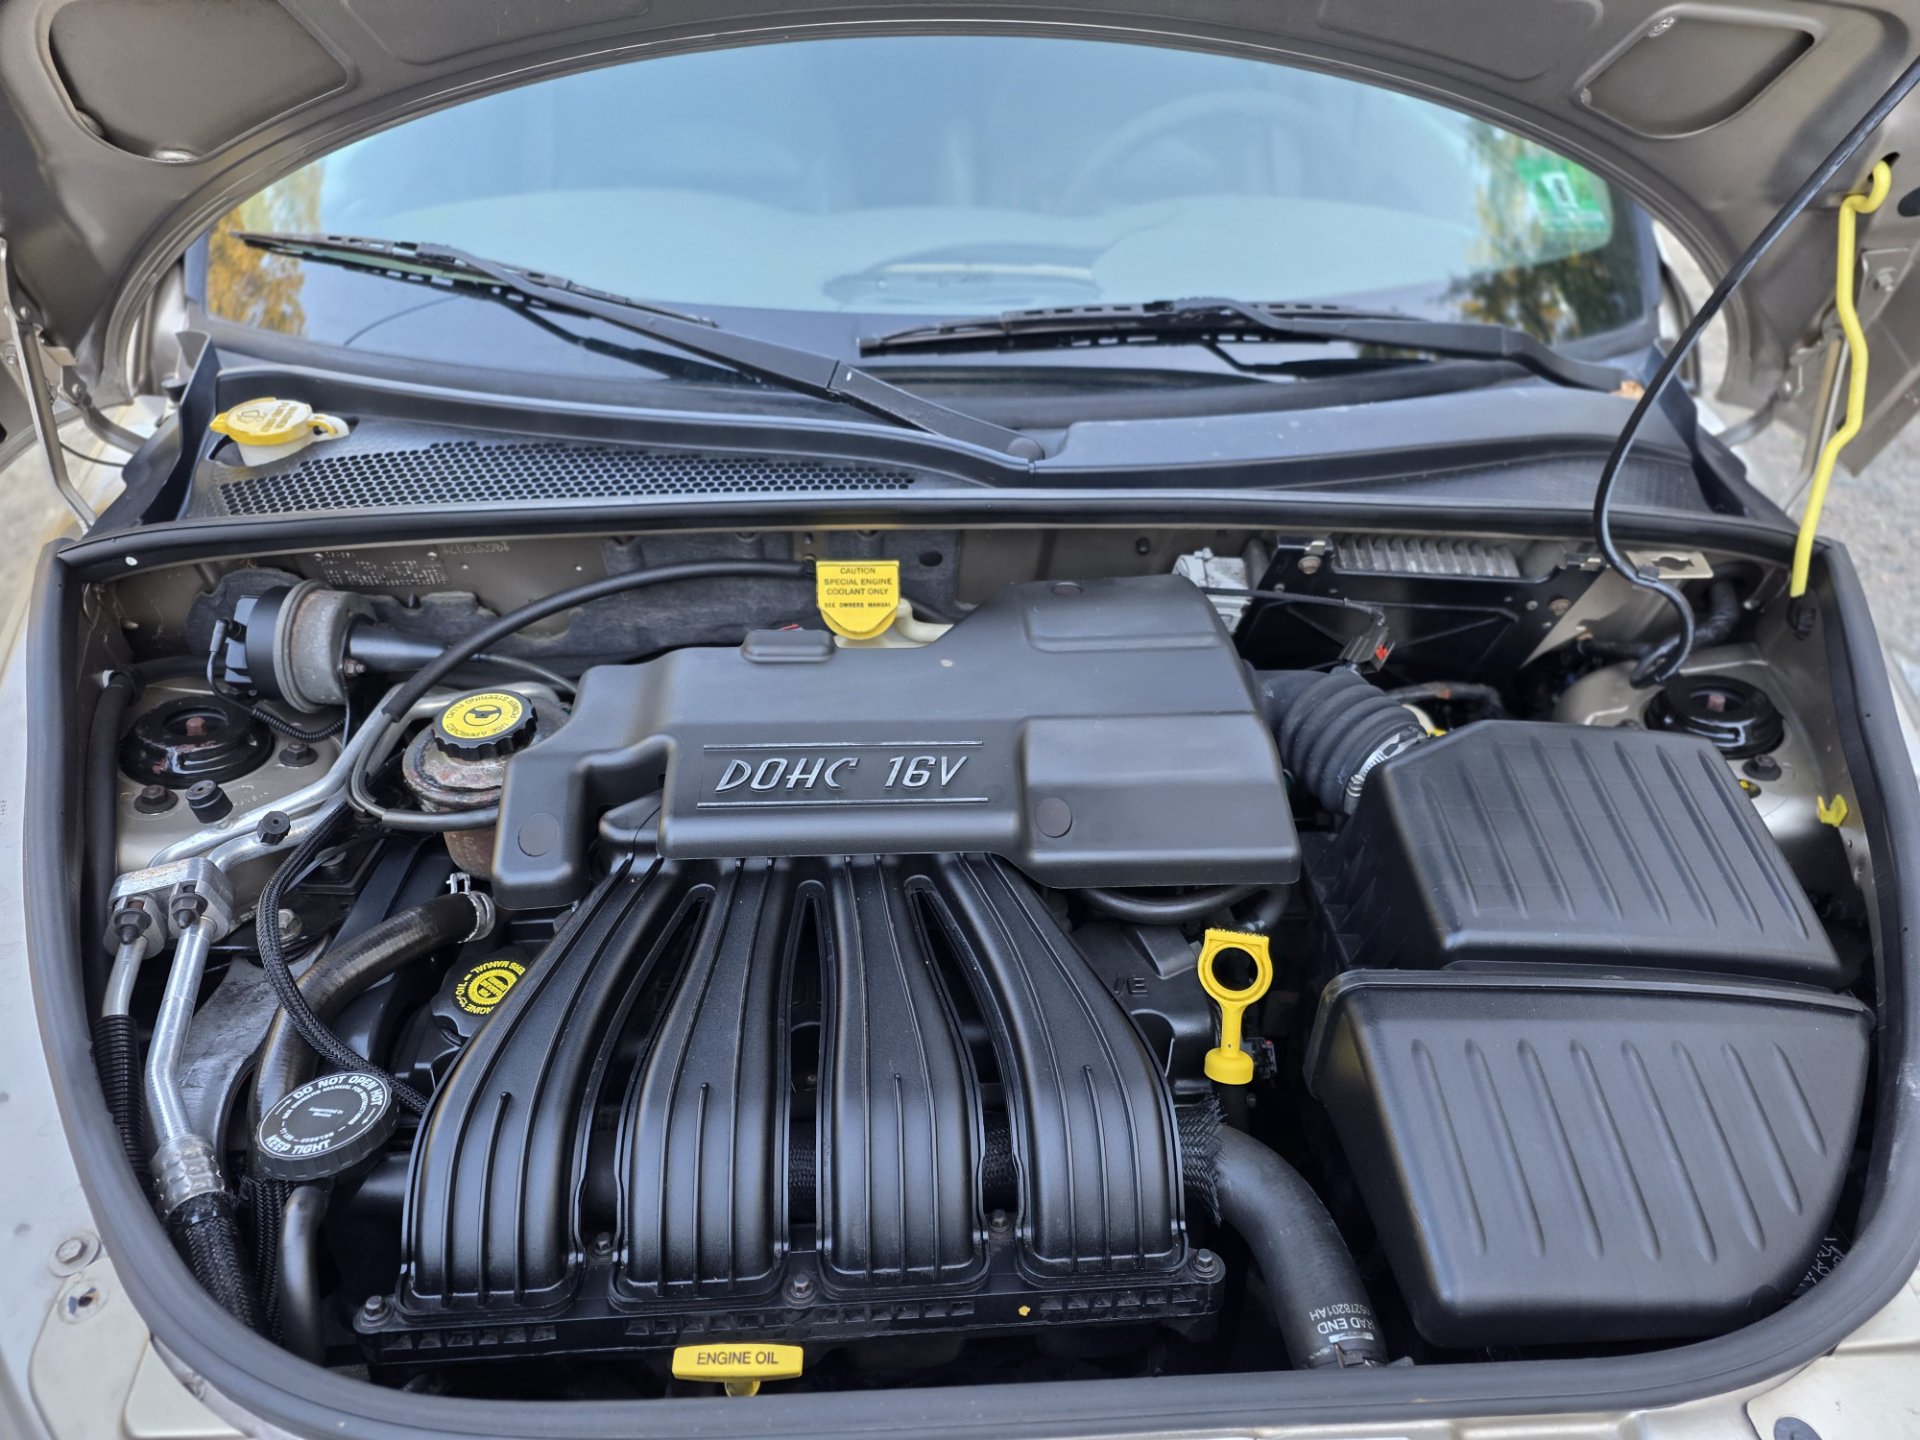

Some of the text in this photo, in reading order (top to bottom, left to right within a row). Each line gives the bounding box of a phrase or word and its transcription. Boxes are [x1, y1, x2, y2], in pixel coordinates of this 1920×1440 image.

[840, 567, 876, 575] CAUTION
[823, 577, 893, 586] SPECIAL ENGINE
[464, 694, 509, 705] STEERING
[714, 755, 969, 793] DOHC 16V
[470, 960, 510, 974] MANUAL
[455, 981, 495, 1015] NGINE OIL
[293, 1075, 384, 1106] DO NOT OPEN HOT
[264, 1134, 292, 1153] KEEP
[291, 1139, 331, 1155] TIGHT
[1317, 1317, 1375, 1334] RAD END
[697, 1351, 779, 1366] ENGINE OIL
